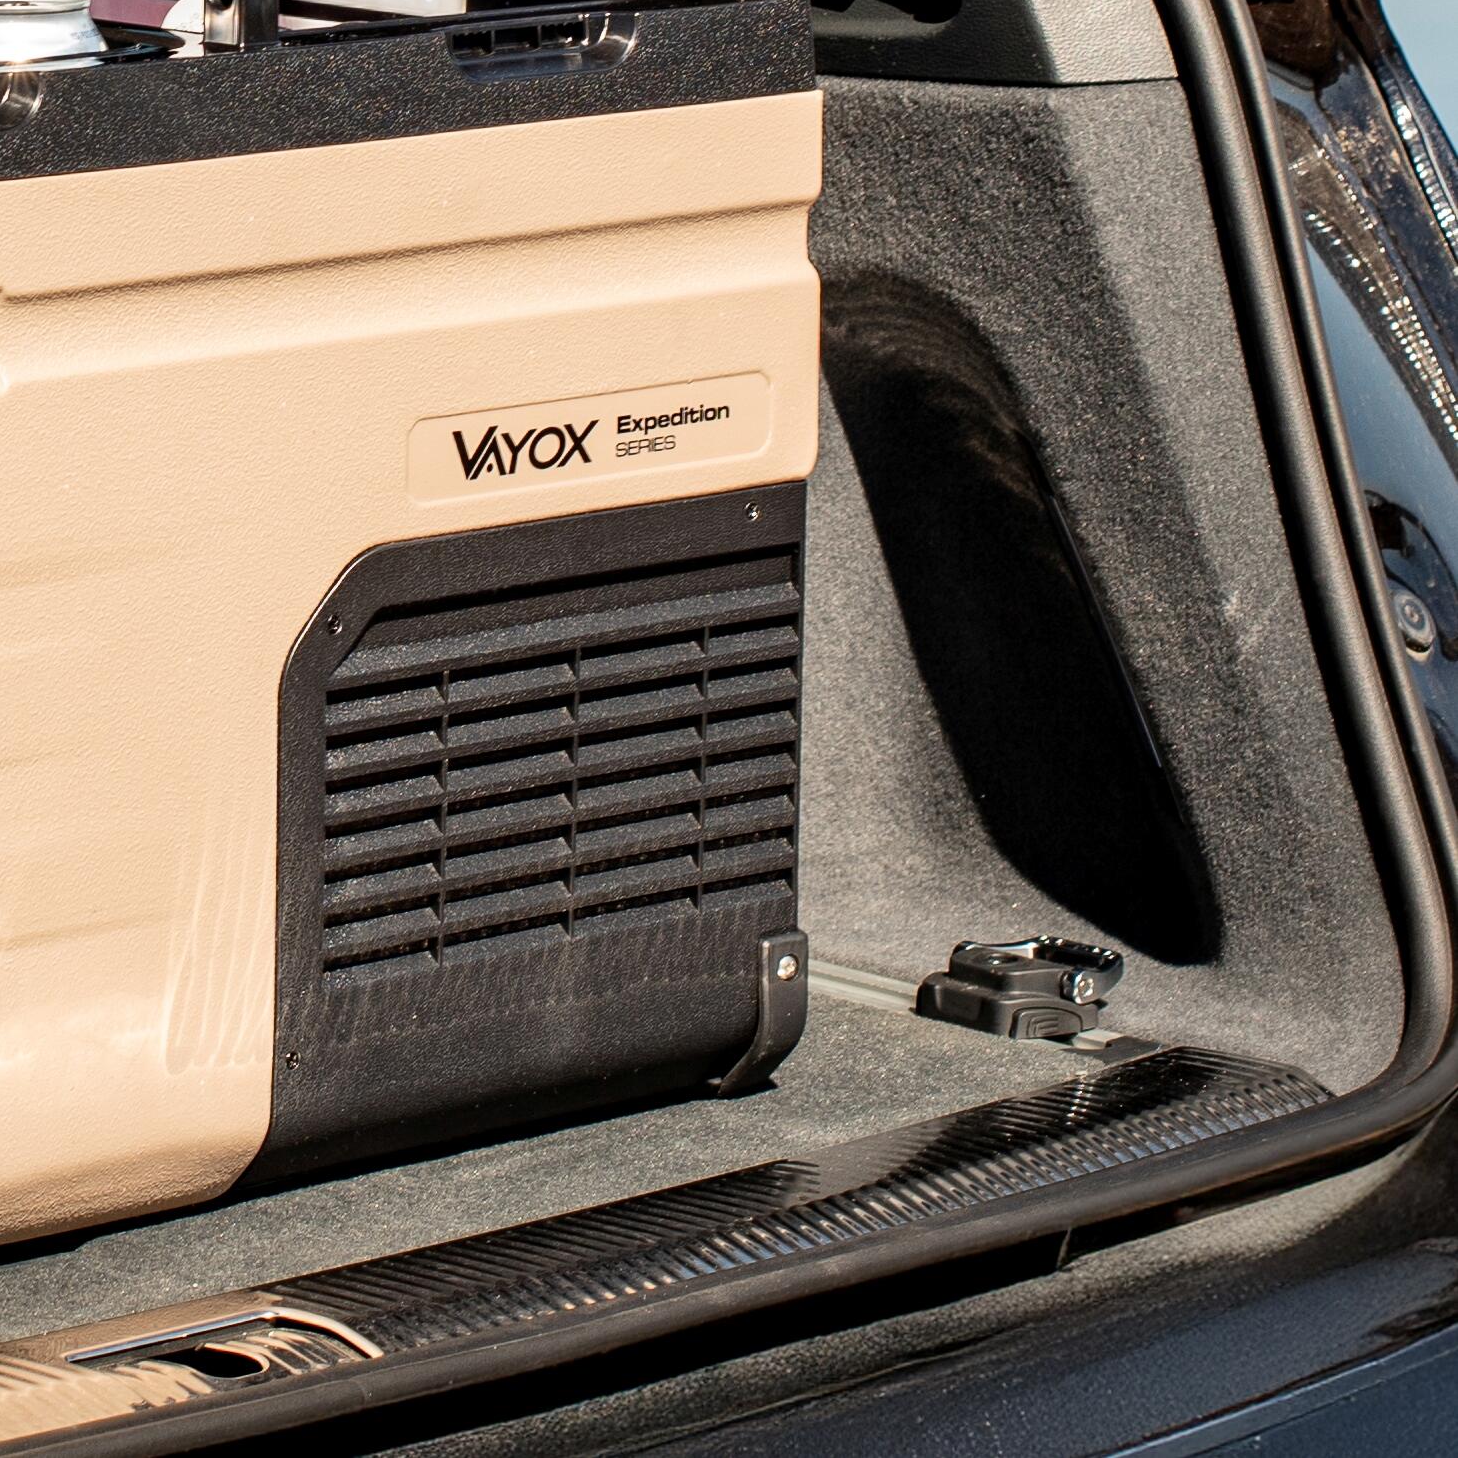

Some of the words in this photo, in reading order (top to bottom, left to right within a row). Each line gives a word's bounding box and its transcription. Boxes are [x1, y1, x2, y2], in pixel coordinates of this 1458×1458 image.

[617, 404, 730, 435] Expedition
[453, 420, 599, 480] VAYOX
[615, 434, 677, 458] SERIES
